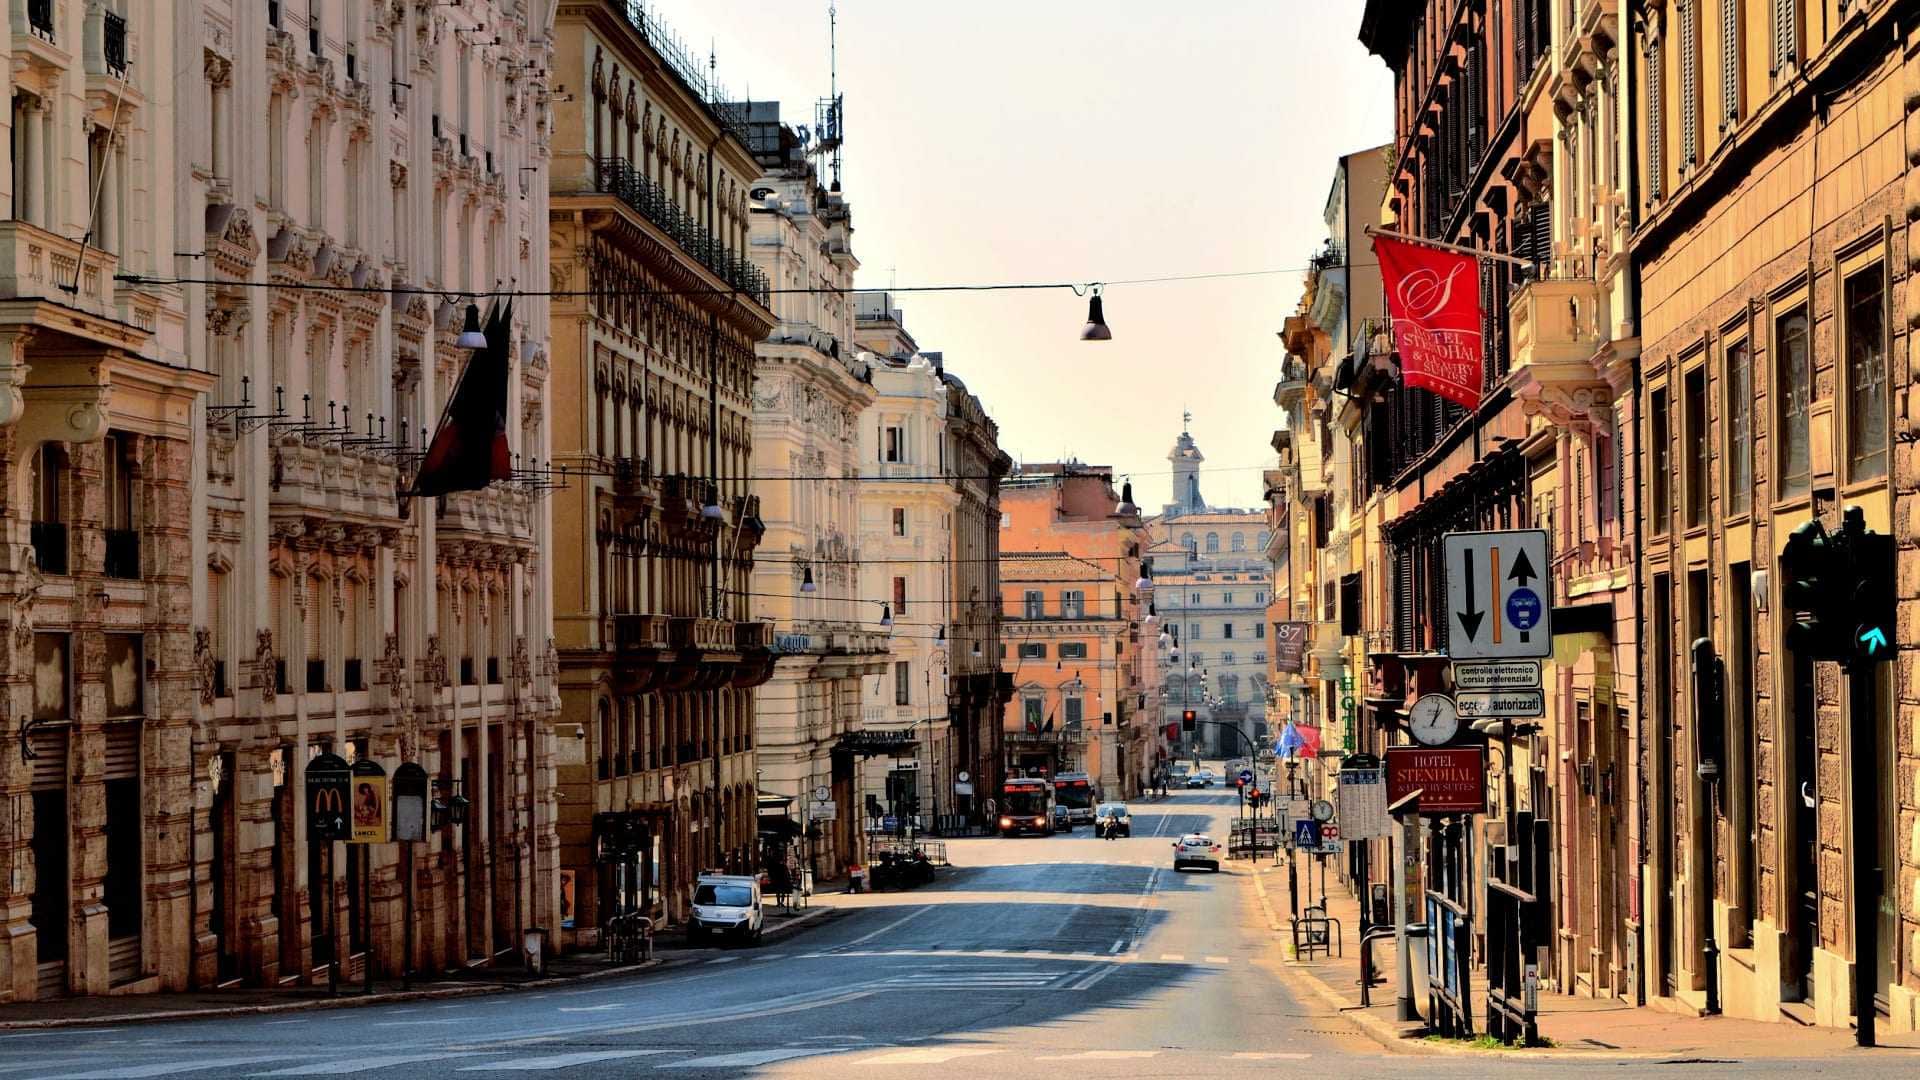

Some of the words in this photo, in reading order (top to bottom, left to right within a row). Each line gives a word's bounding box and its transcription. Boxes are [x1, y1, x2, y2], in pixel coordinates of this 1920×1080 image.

[1413, 325, 1464, 346] HOTEL
[1402, 333, 1478, 362] STENDHAL
[1413, 351, 1423, 361] &
[1279, 624, 1301, 641] 87
[1461, 666, 1493, 675] controllo
[1494, 665, 1534, 674] elettronico
[1463, 675, 1485, 684] corsia
[1486, 674, 1533, 684] preferenziale
[1493, 698, 1539, 711] autorizzati
[1414, 755, 1456, 768] HOTEL
[1397, 768, 1475, 782] STENDHAL
[1443, 783, 1475, 792] SUITES
